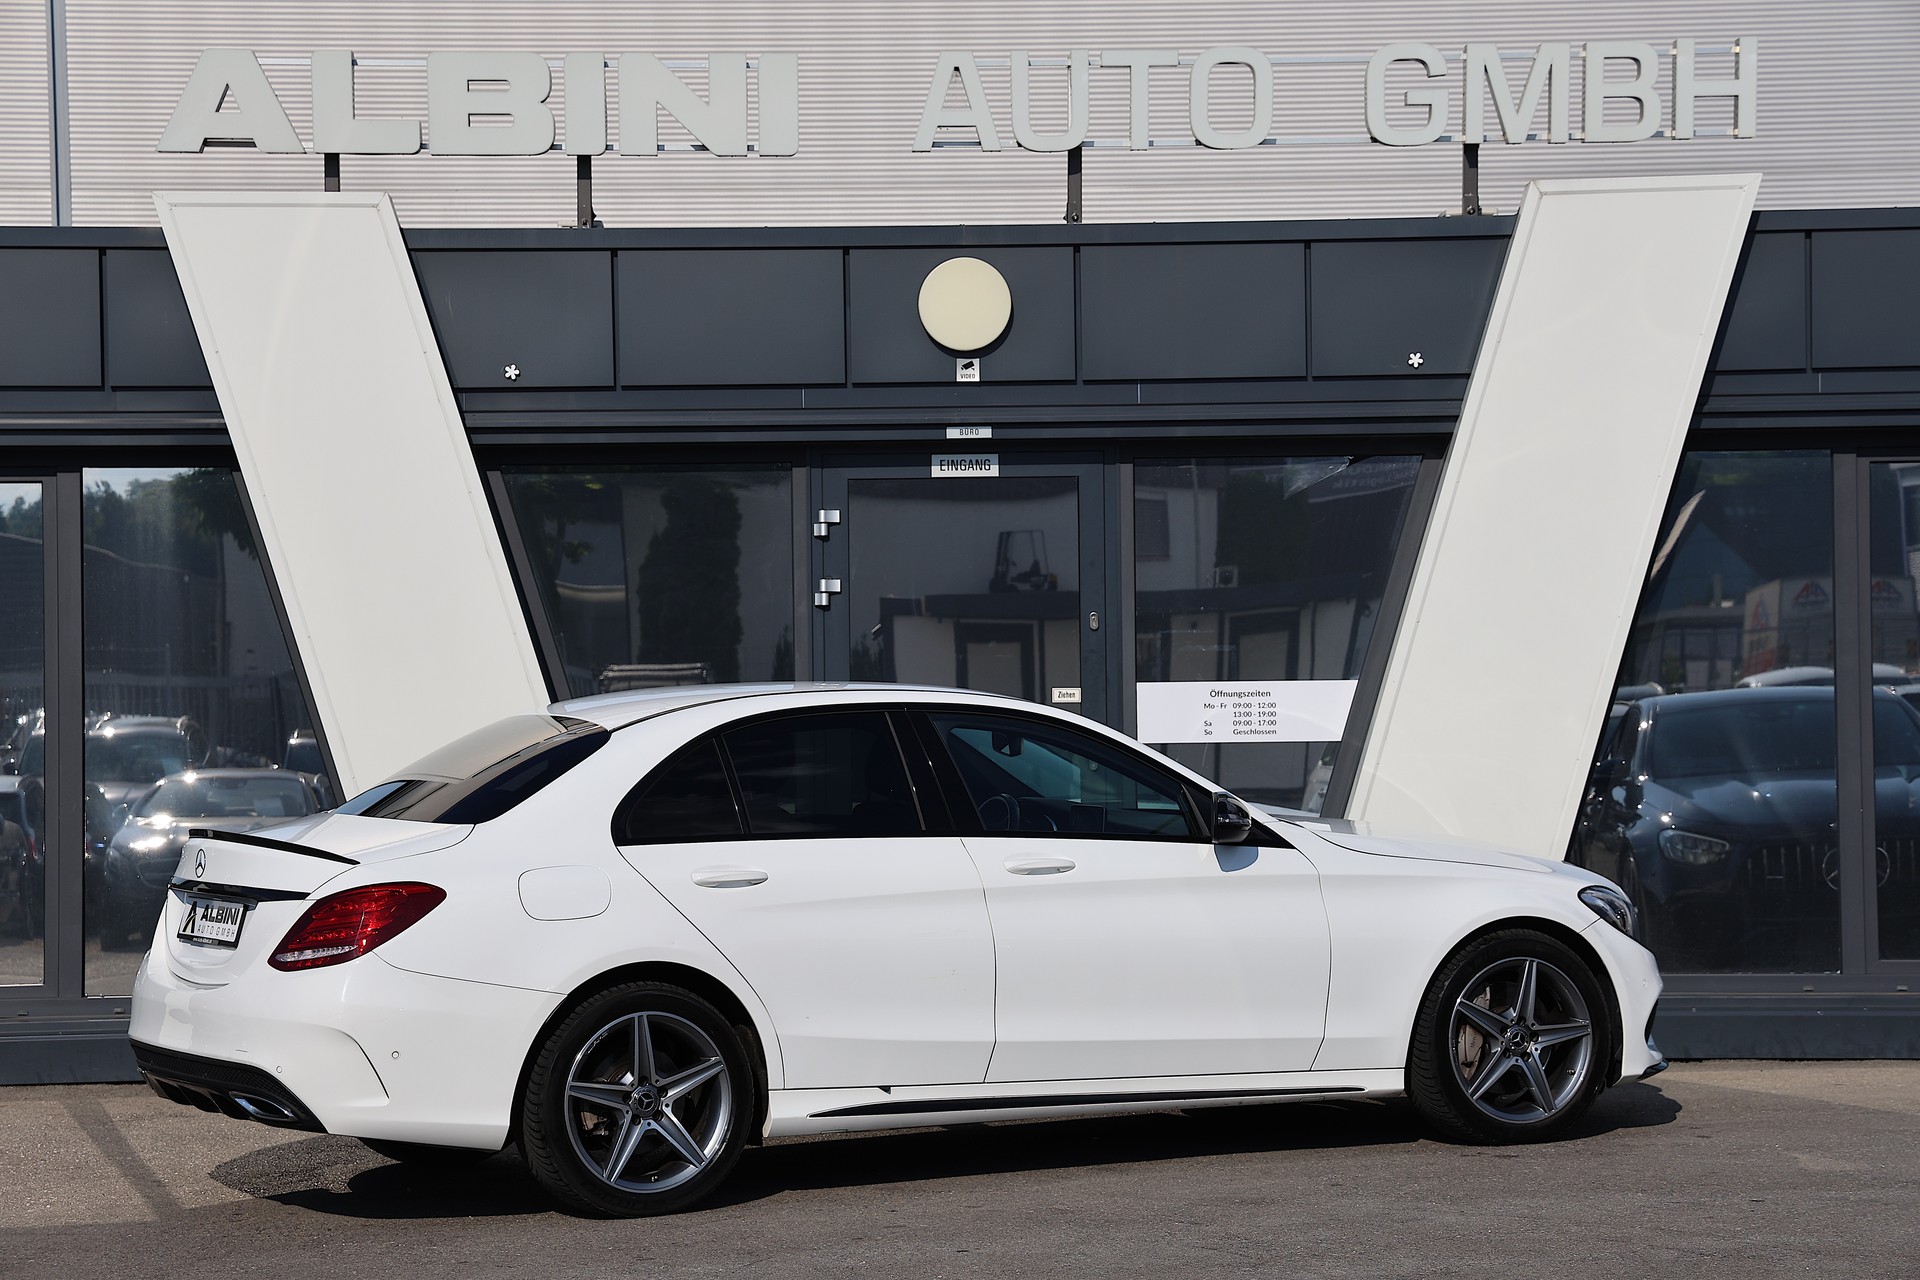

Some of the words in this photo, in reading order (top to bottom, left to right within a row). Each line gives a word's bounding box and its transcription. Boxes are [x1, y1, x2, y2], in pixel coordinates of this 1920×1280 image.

[156, 47, 799, 158] ALBINI
[911, 45, 1275, 153] AUTO
[1364, 36, 1761, 146] GMBH
[939, 458, 991, 471] EINGANG
[1209, 689, 1271, 699] Öffnungszeiten
[200, 904, 240, 925] ALBINI
[197, 924, 214, 935] AUTO
[215, 926, 236, 938] GMBH
